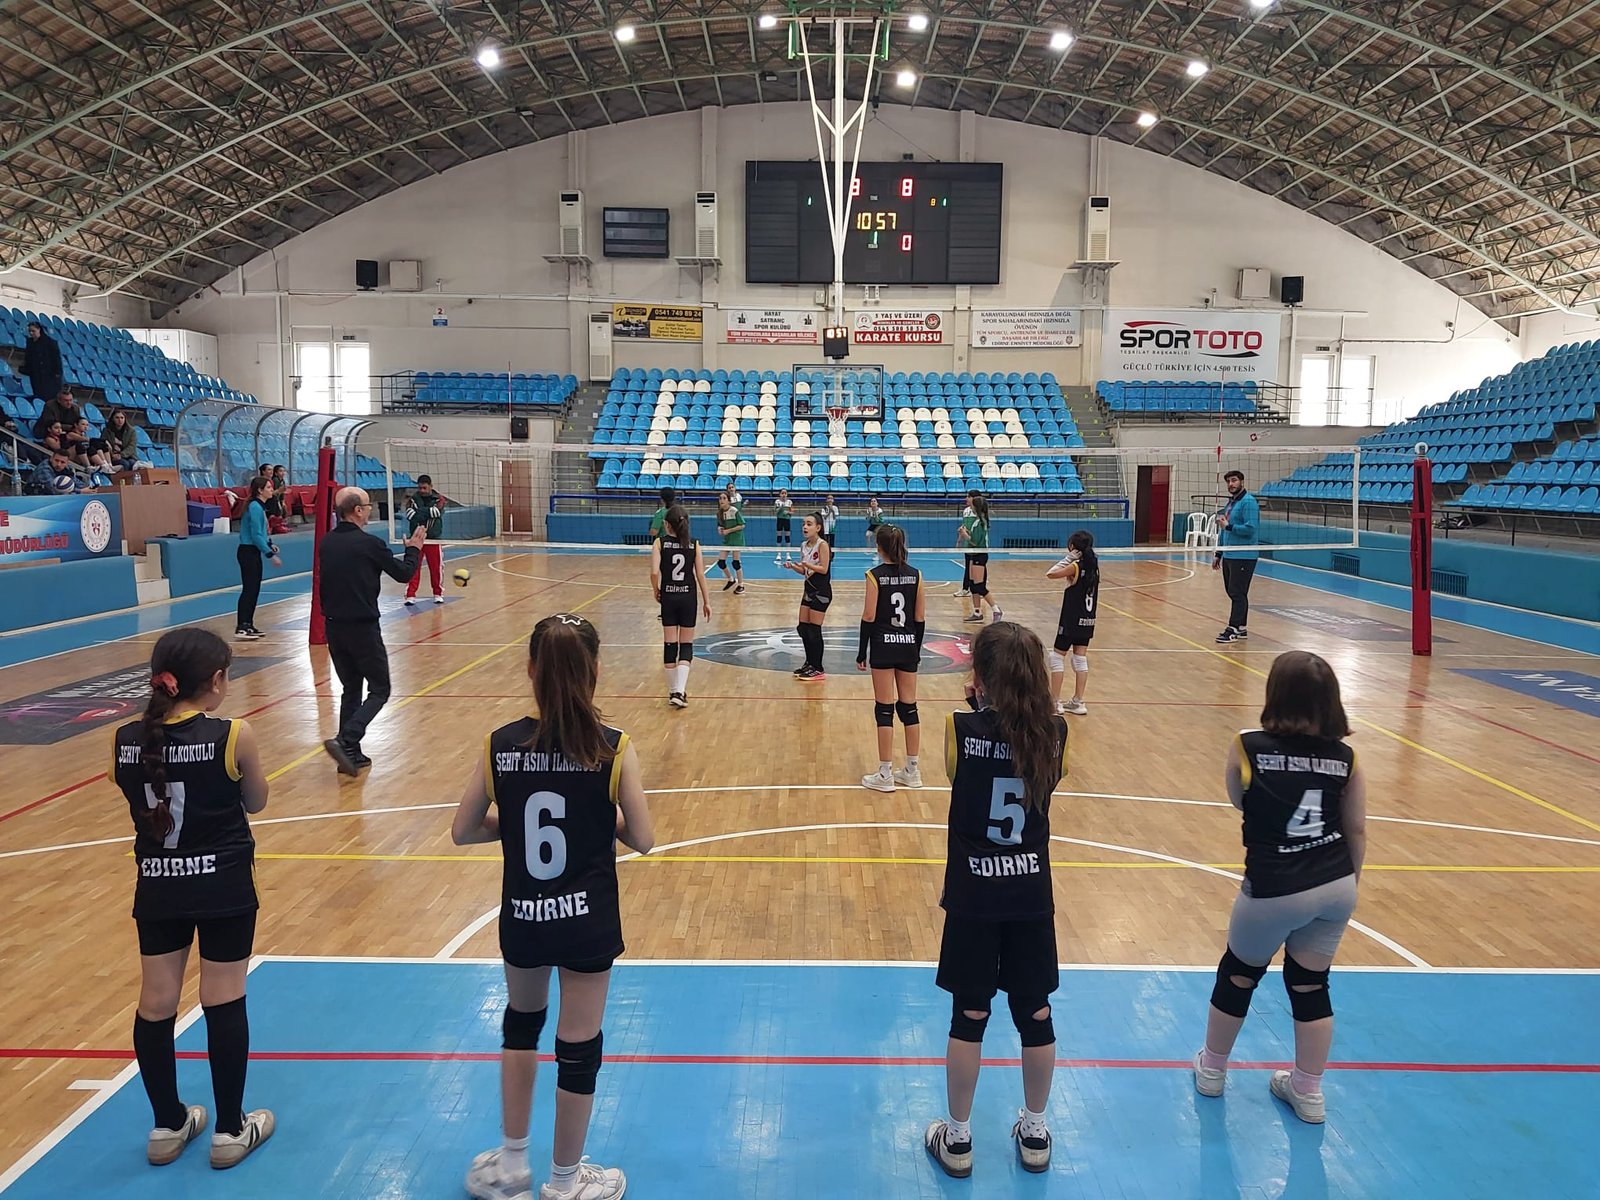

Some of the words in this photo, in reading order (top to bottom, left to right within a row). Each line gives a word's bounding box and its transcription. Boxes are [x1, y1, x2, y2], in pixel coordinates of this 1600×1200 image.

[902, 179, 913, 196] 8
[902, 235, 912, 250] 0
[856, 333, 901, 341] KARATE
[905, 333, 940, 341] KURSU
[1123, 363, 1152, 371] GÜÇLÜ
[1194, 364, 1211, 372] İÇİN
[672, 554, 685, 581] 2
[813, 551, 818, 560] 9
[891, 592, 906, 627] 3
[884, 632, 915, 643] EDİRNE
[119, 741, 141, 768] ŞEHİT
[169, 741, 215, 763] İLKOKULU
[964, 736, 992, 759] ŞEHİT
[496, 746, 521, 777] ŞEHİT
[523, 752, 549, 772] ASIM
[144, 782, 186, 849] 7
[987, 777, 1026, 846] 5
[1286, 790, 1326, 838] 4
[524, 791, 567, 880] 6
[968, 853, 1040, 877] EDİRNE
[511, 890, 589, 922] EDİRNE
